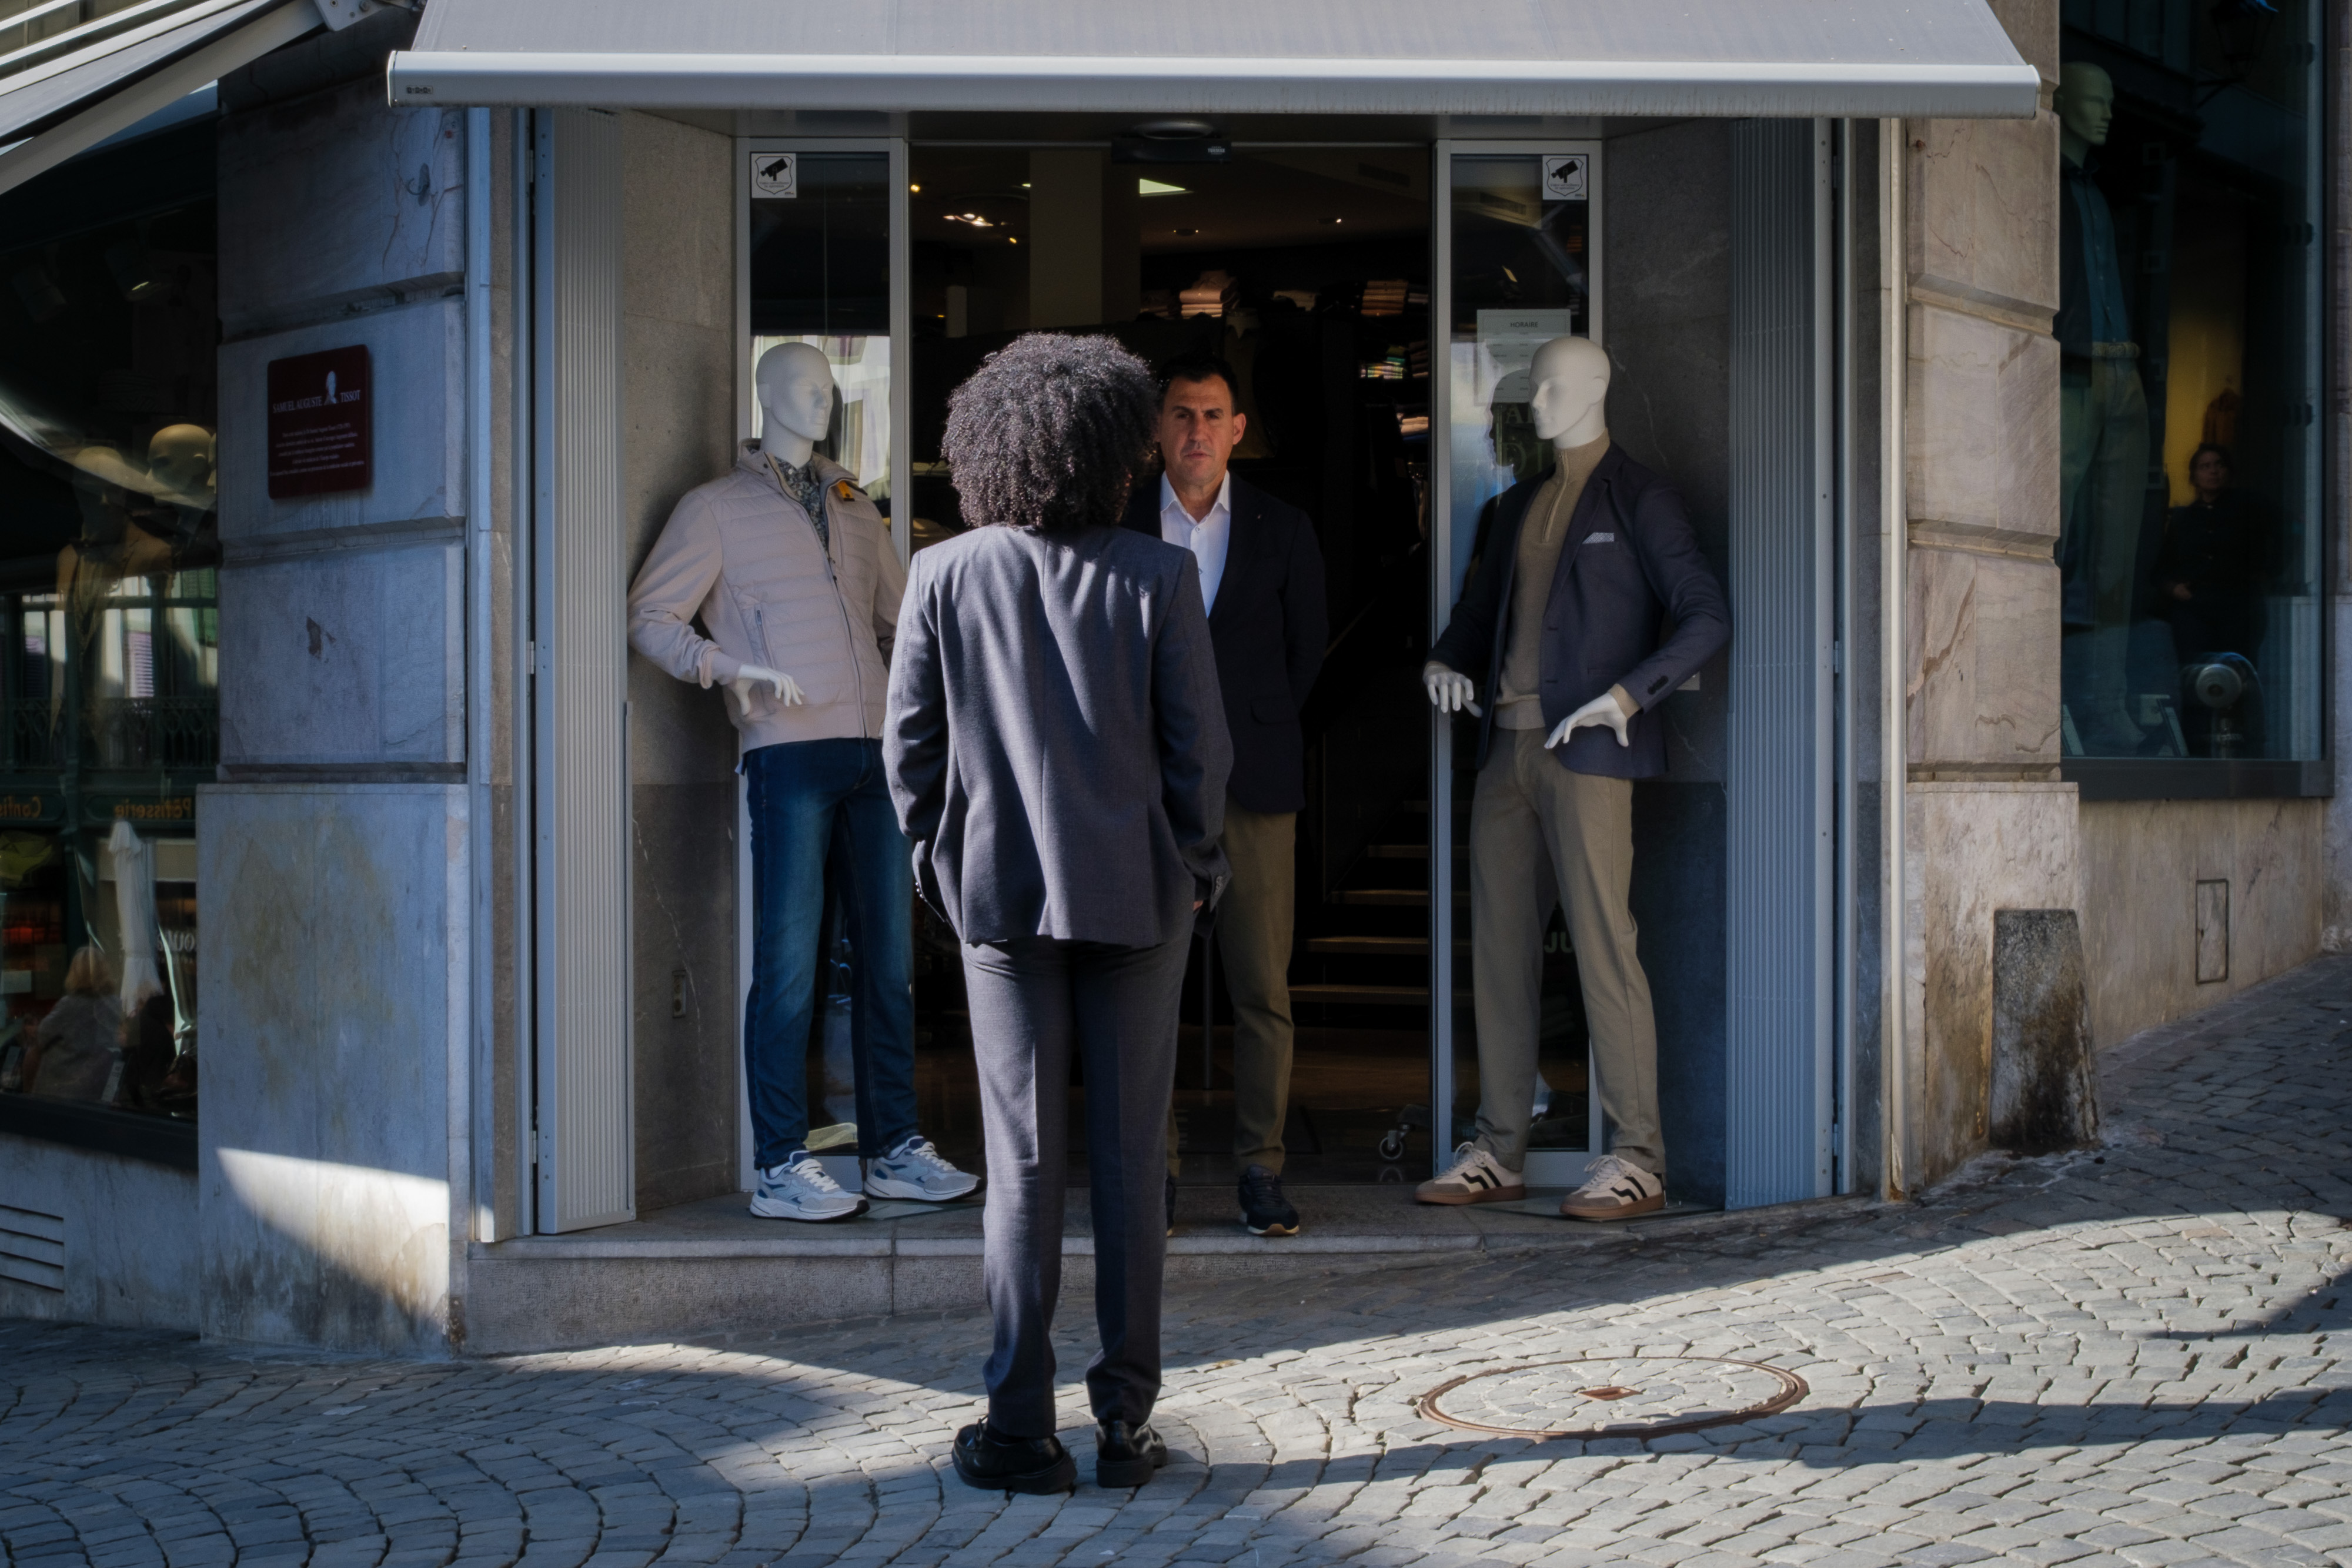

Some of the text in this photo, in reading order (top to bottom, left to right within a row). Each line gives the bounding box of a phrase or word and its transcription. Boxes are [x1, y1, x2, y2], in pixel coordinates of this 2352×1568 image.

[272, 390, 361, 413] SAMUEL AUGUSTE TISSOT
